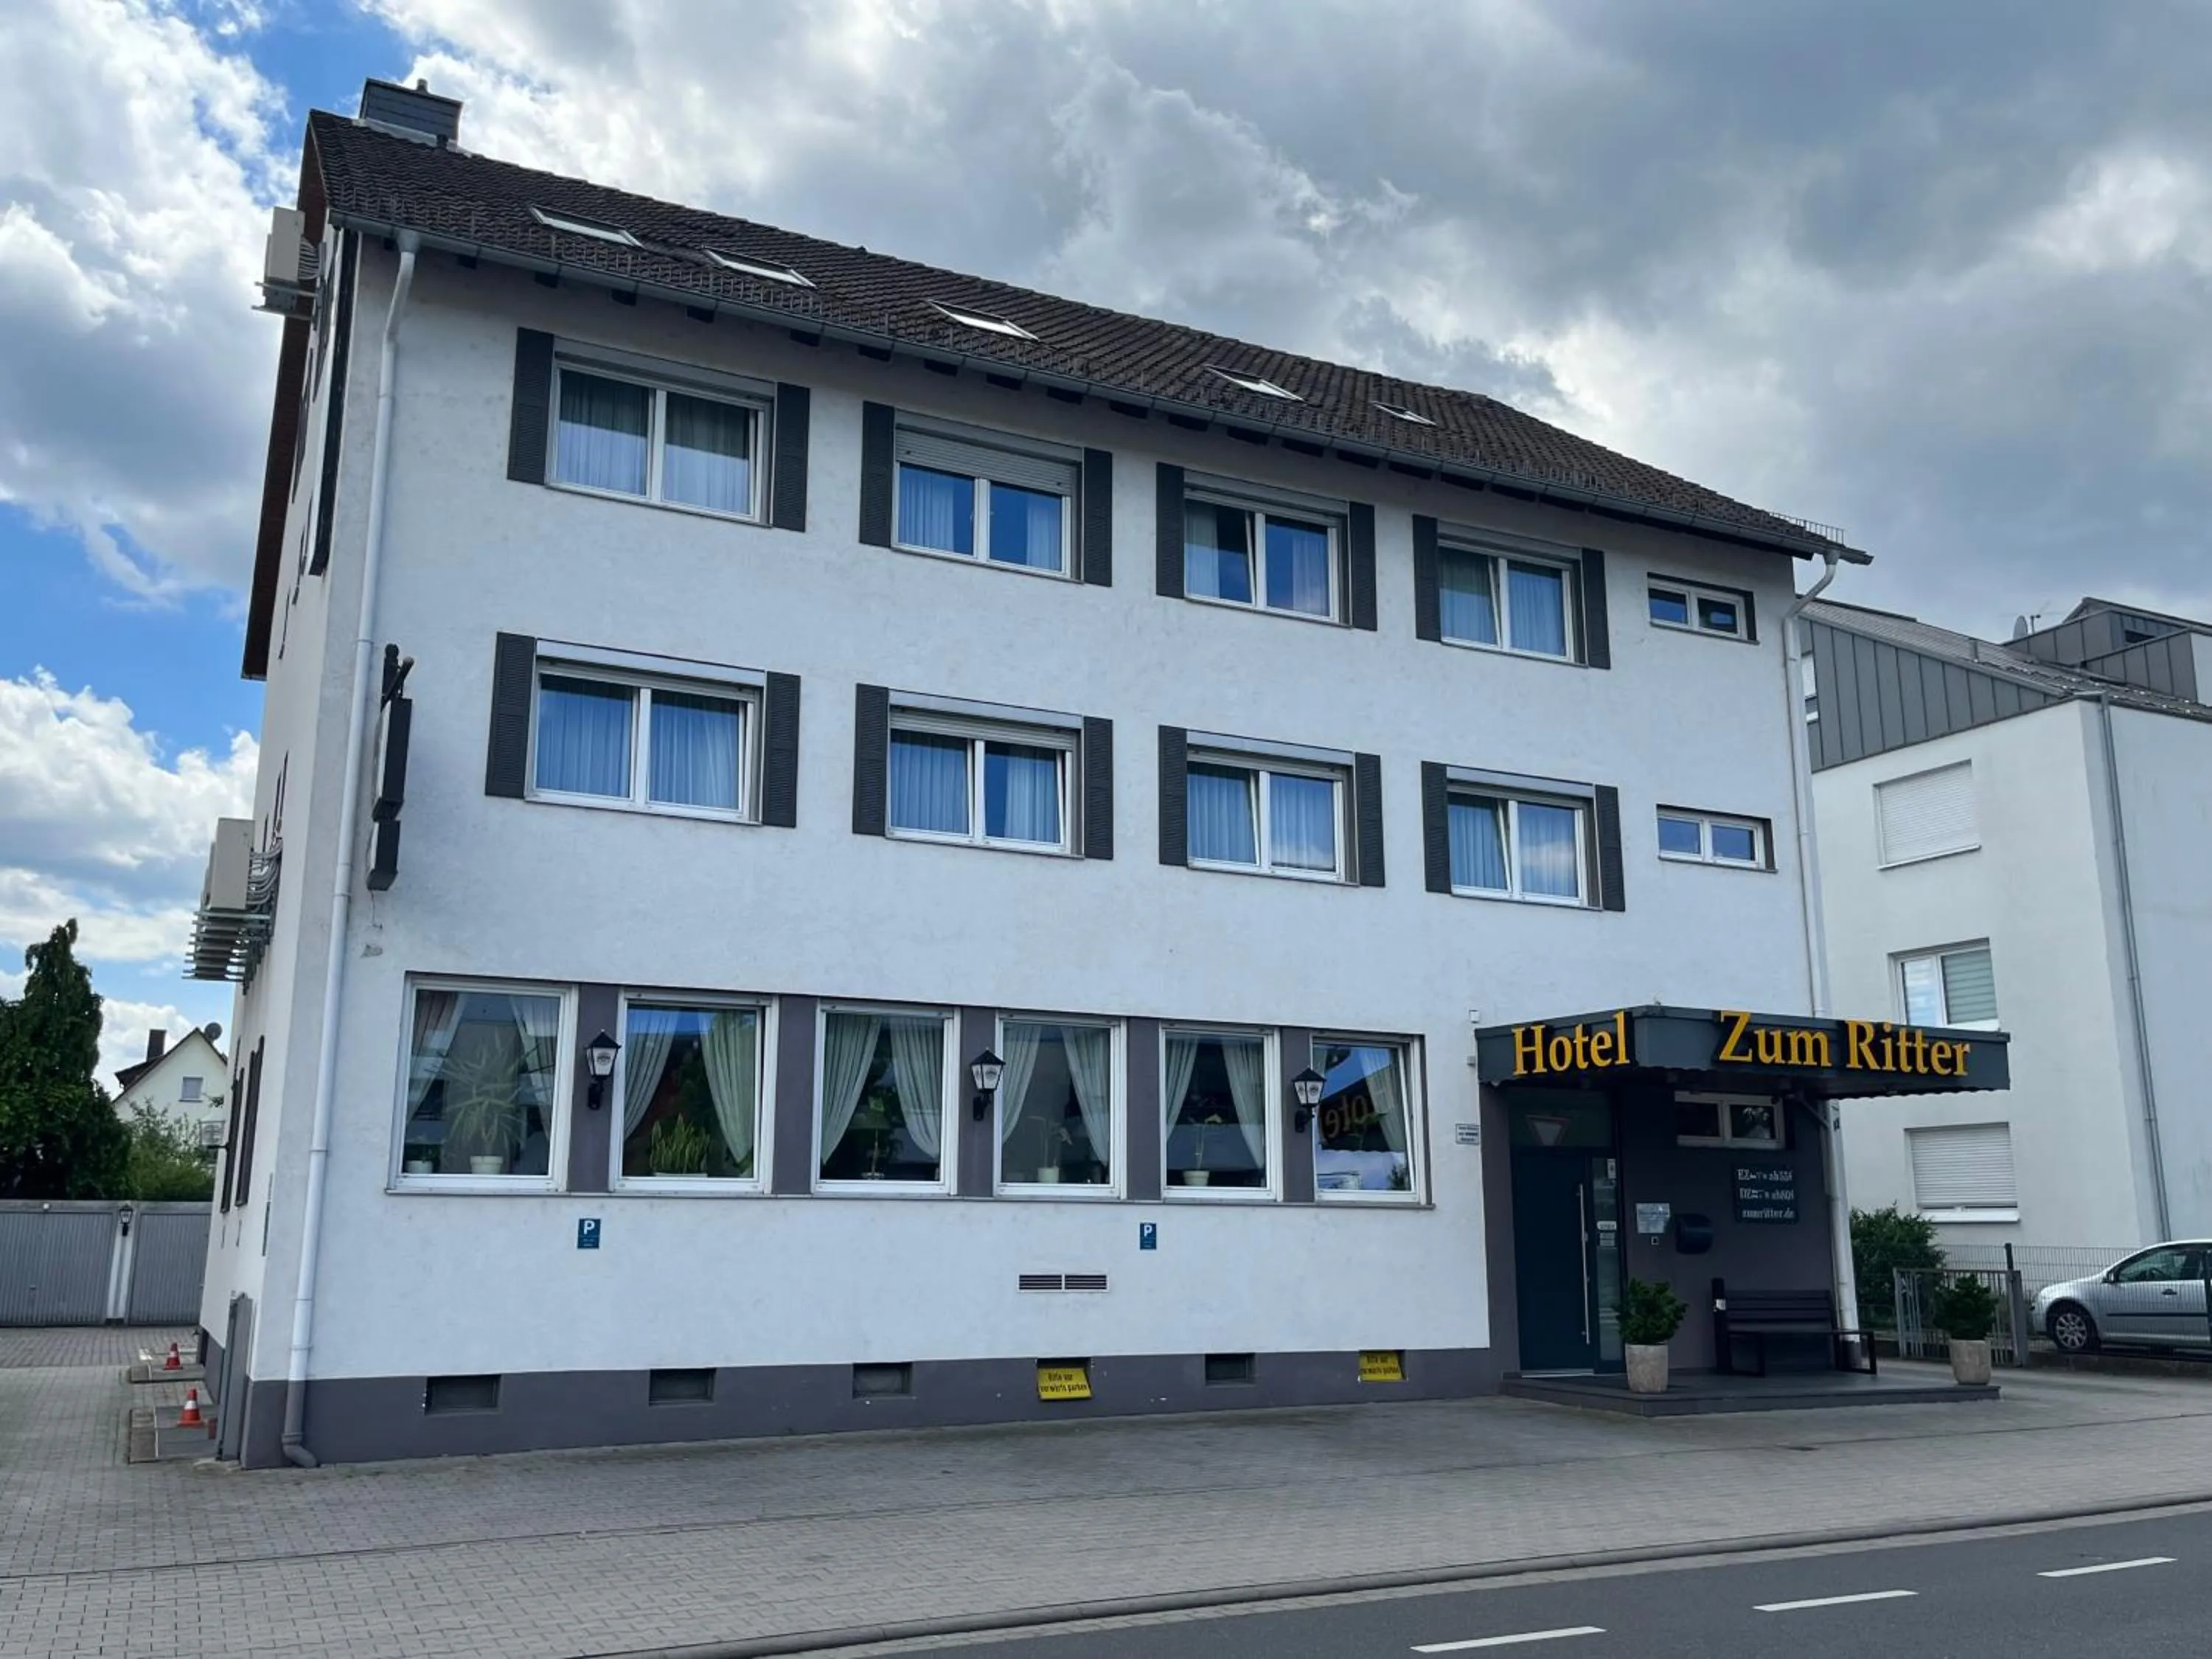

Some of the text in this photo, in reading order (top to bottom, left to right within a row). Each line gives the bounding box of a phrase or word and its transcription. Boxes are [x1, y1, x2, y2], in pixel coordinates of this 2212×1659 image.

[1512, 1011, 1630, 1075] Hotel
[1719, 1011, 1970, 1077] Zum Ritter
[584, 1220, 595, 1234] P
[1144, 1225, 1152, 1237] P
